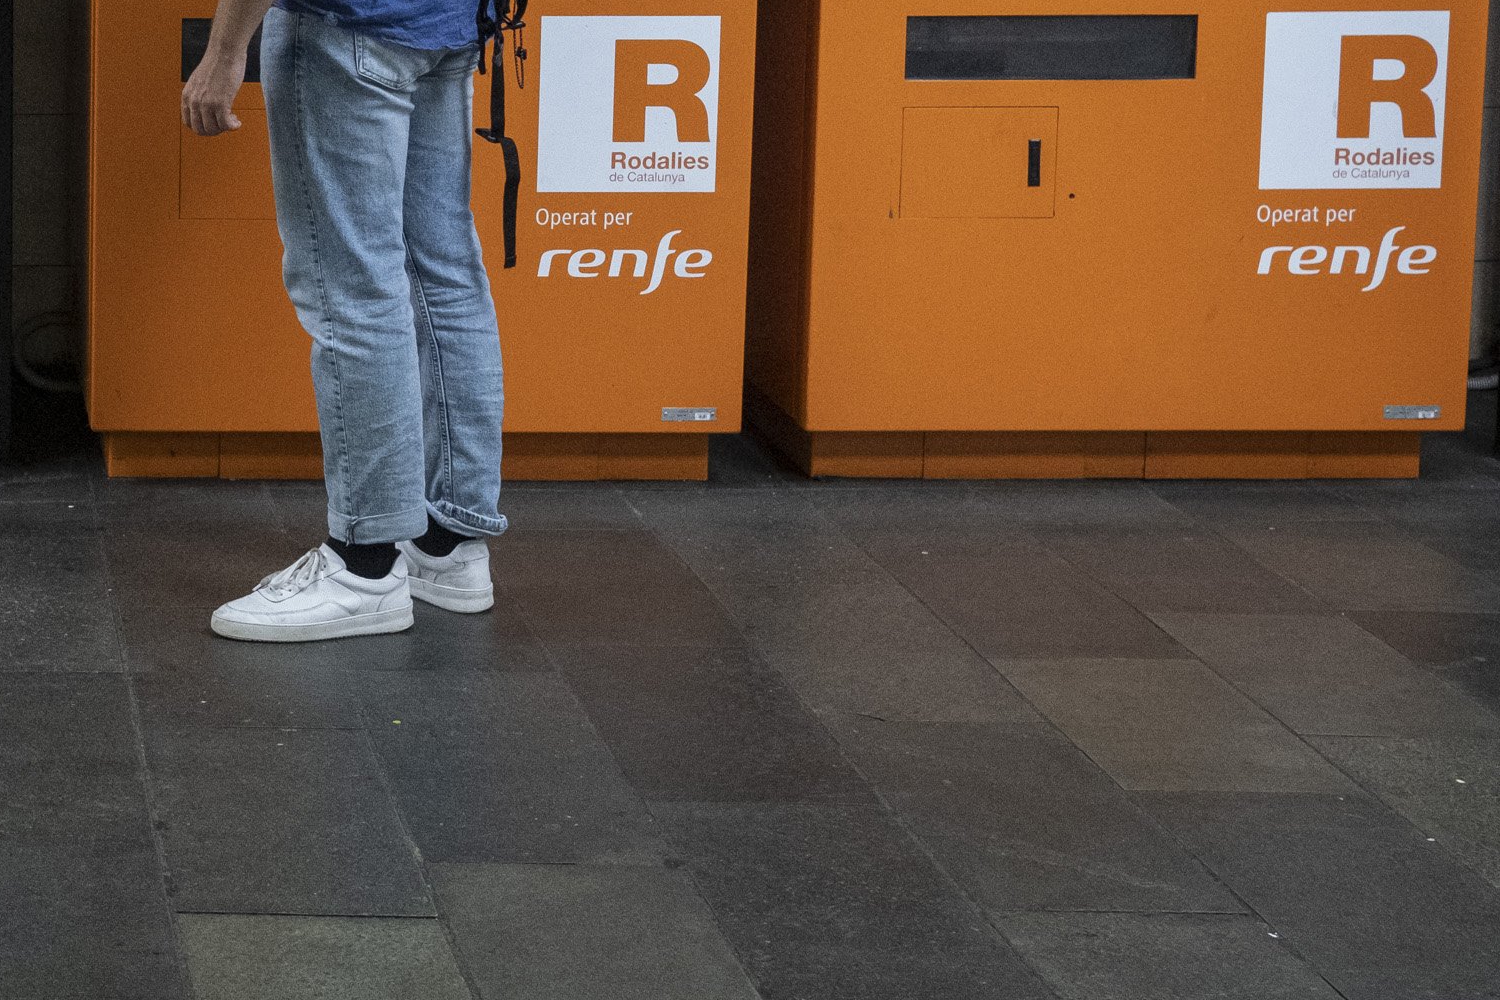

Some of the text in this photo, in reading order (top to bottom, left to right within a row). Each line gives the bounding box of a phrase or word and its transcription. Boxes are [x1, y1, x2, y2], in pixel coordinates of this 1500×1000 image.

[610, 151, 709, 170] Rodalies
[1334, 148, 1435, 166] Rodalies
[609, 172, 685, 184] de Catalunya
[1332, 168, 1410, 180] de Catalunya
[535, 208, 633, 230] Operat per
[1257, 204, 1356, 227] Operat per
[537, 229, 713, 295] renfe
[1257, 225, 1437, 292] renfe
